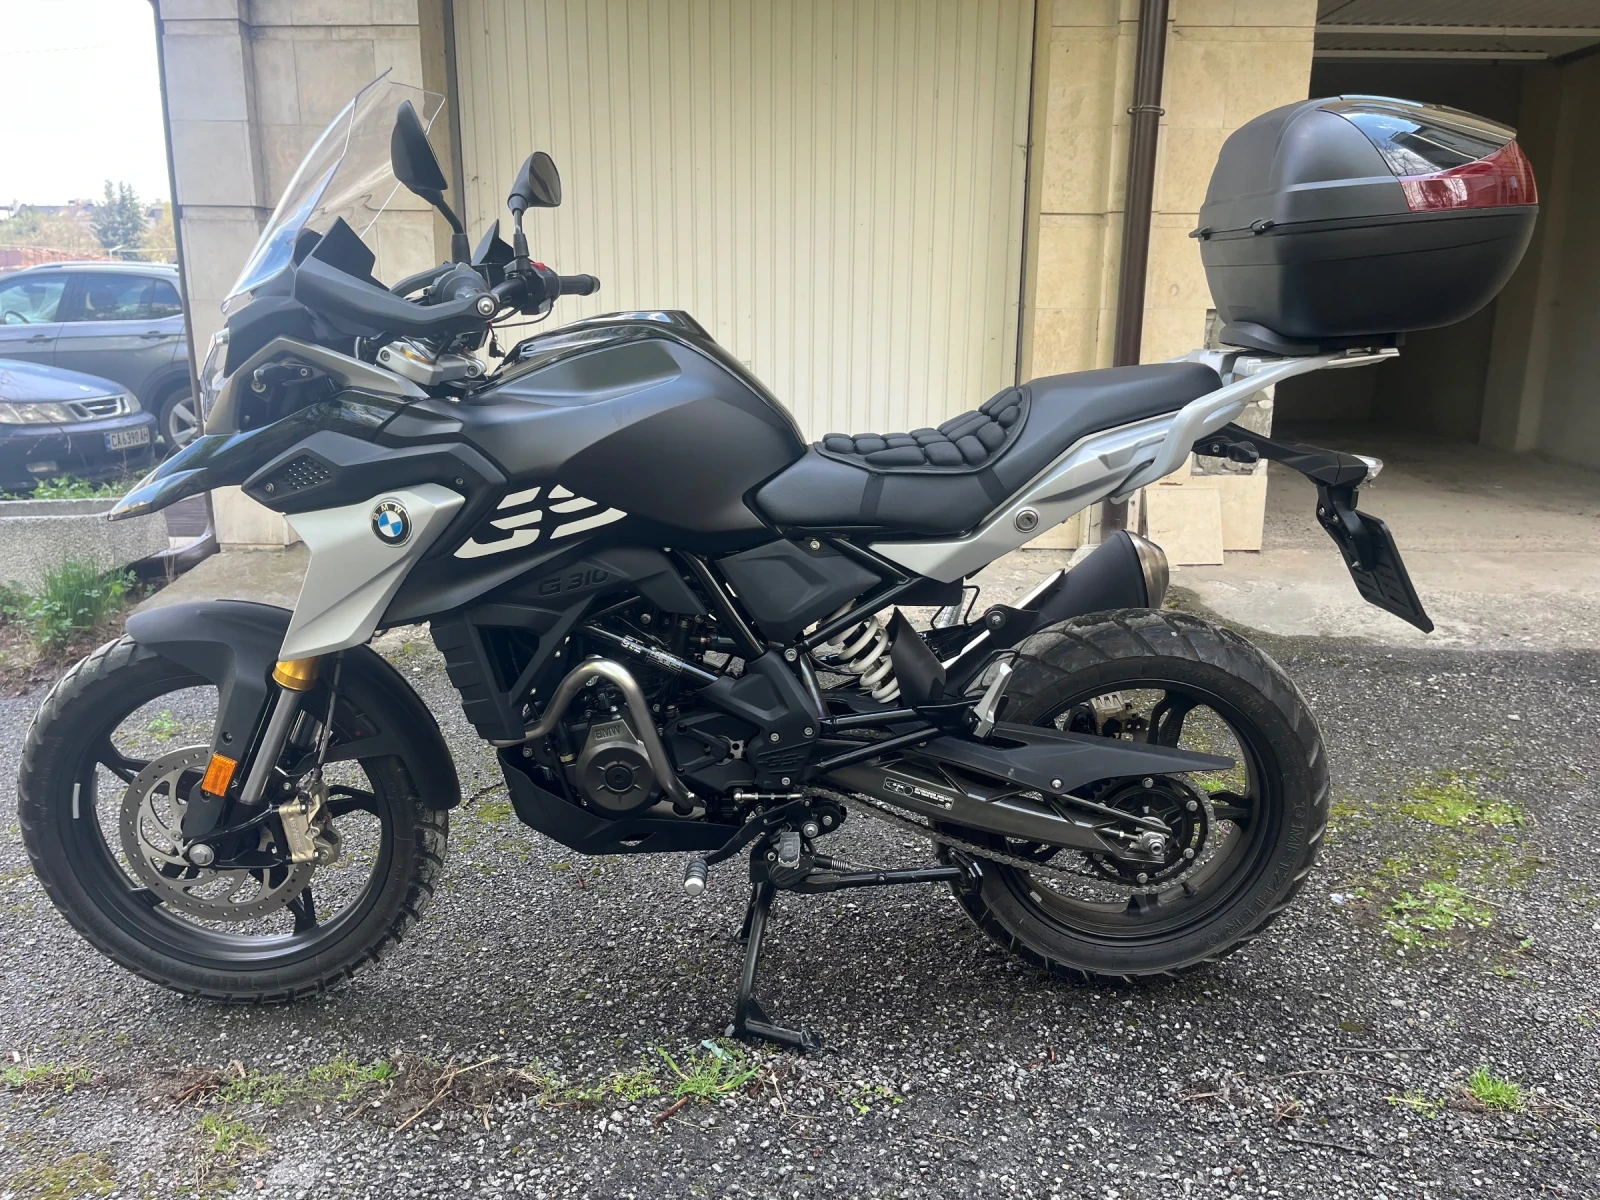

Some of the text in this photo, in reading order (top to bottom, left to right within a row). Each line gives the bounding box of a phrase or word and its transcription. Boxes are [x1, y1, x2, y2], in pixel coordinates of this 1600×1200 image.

[372, 503, 403, 521] BMW
[538, 569, 608, 597] G 310
[594, 725, 621, 740] BMW
[290, 820, 303, 851] BYBRE
[1226, 823, 1305, 936] METZELER
